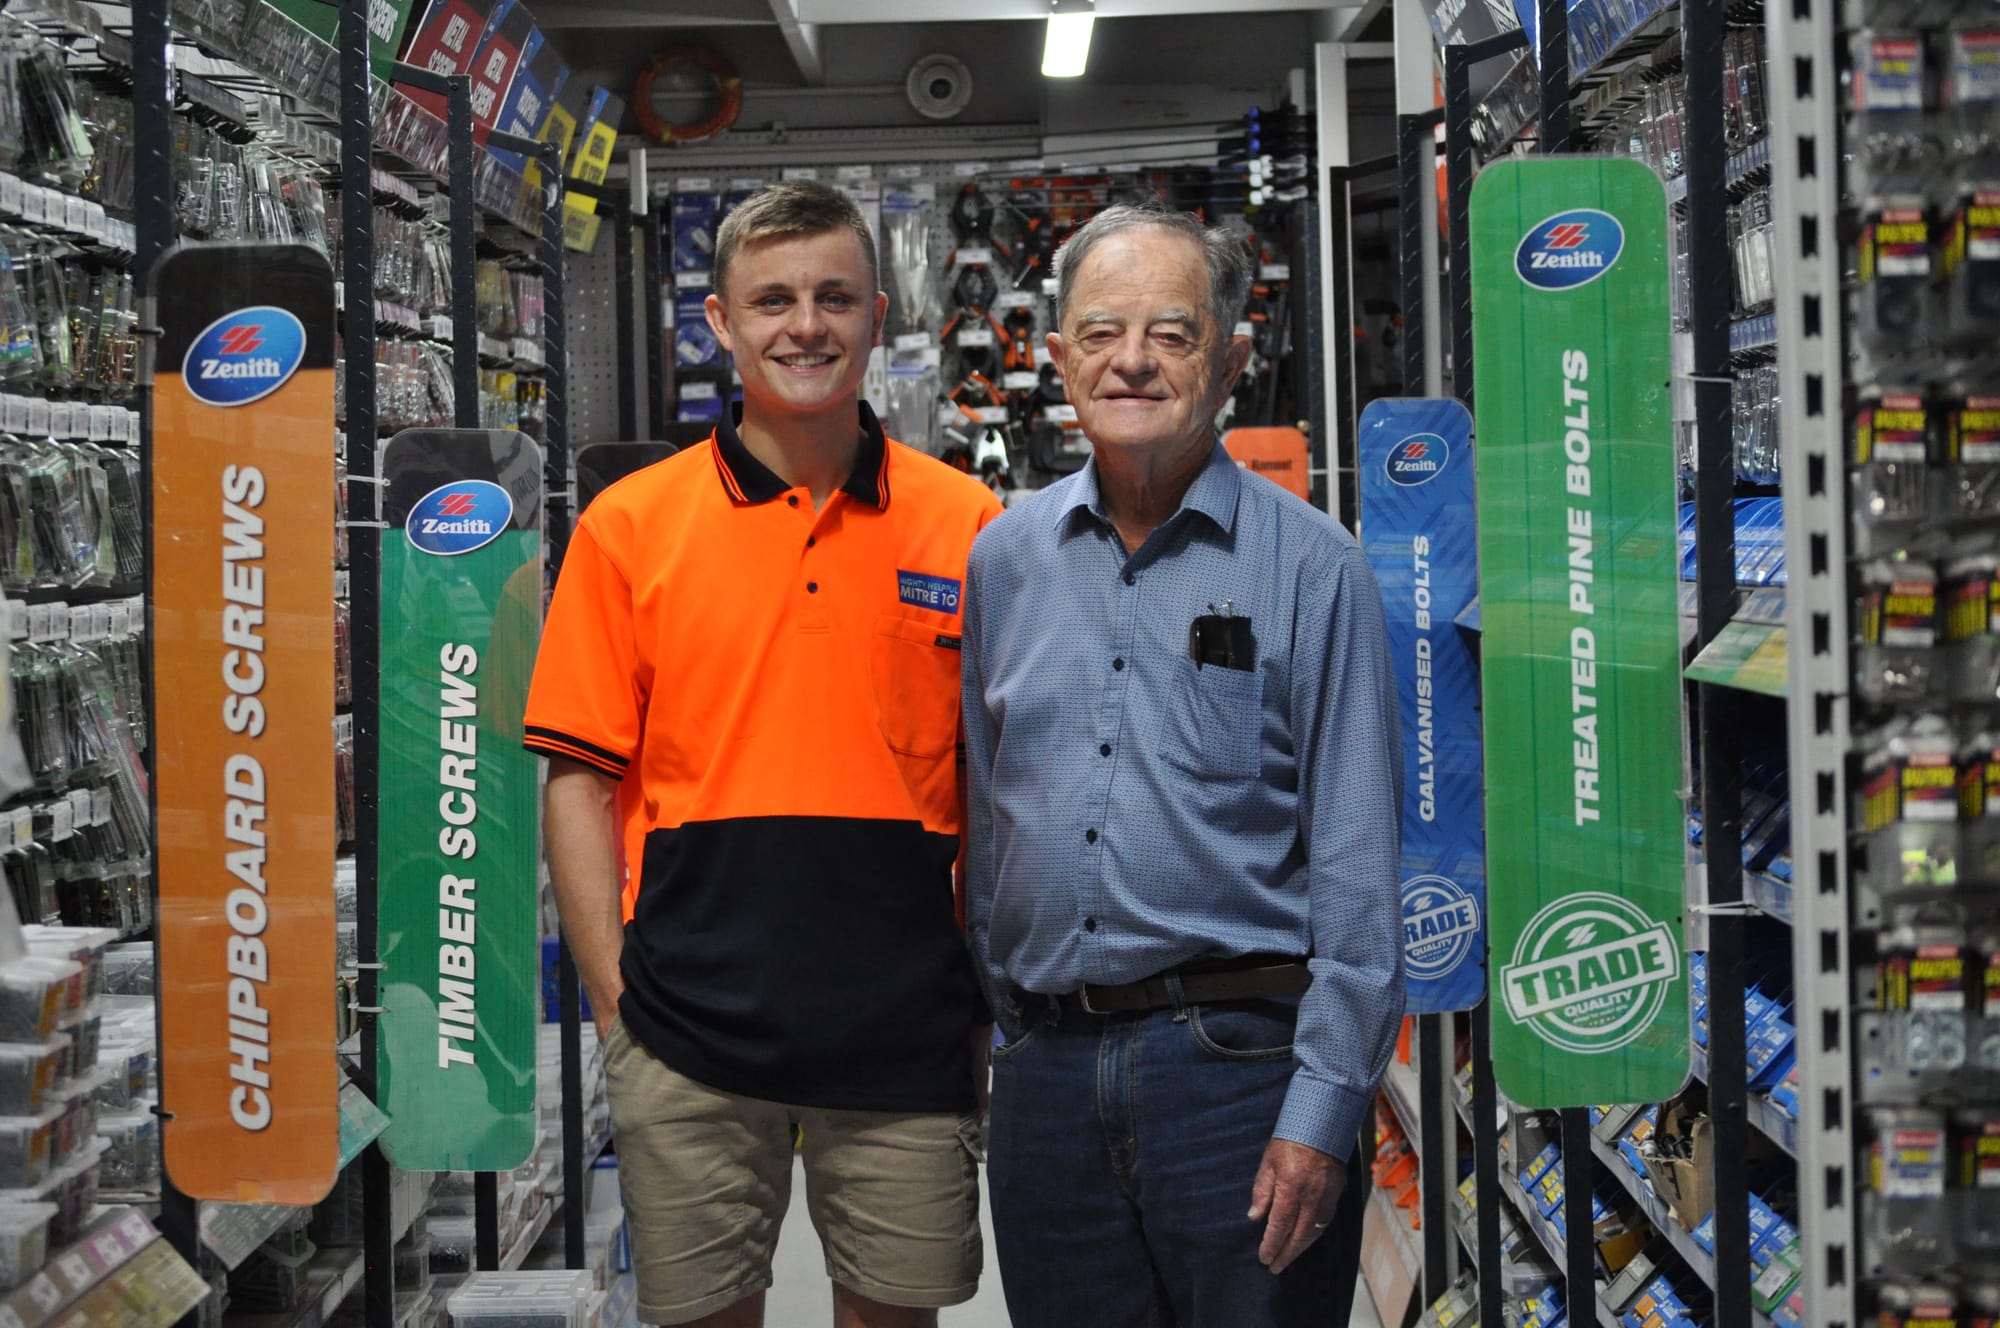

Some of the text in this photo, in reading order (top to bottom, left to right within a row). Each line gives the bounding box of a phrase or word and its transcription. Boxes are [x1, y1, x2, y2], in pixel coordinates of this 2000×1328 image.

[1531, 251, 1602, 269] Zenith
[200, 357, 281, 379] Zenith
[1395, 459, 1438, 472] Zenith
[421, 517, 492, 535] Zenith
[900, 585, 958, 608] MITRE 10
[927, 581, 959, 595] HELPFUL
[1562, 350, 1600, 827] TREATED PINE BOLTS
[1413, 534, 1435, 822] GALVANISED BOLTS
[222, 464, 272, 1131] CHIPBOARD SCREWS
[438, 642, 478, 1070] TIMBER SCREWS
[1404, 904, 1472, 945] RADE
[1412, 937, 1453, 957] QUALITY
[1512, 938, 1666, 1008] TRADE
[1564, 988, 1633, 1018] QUALITY
